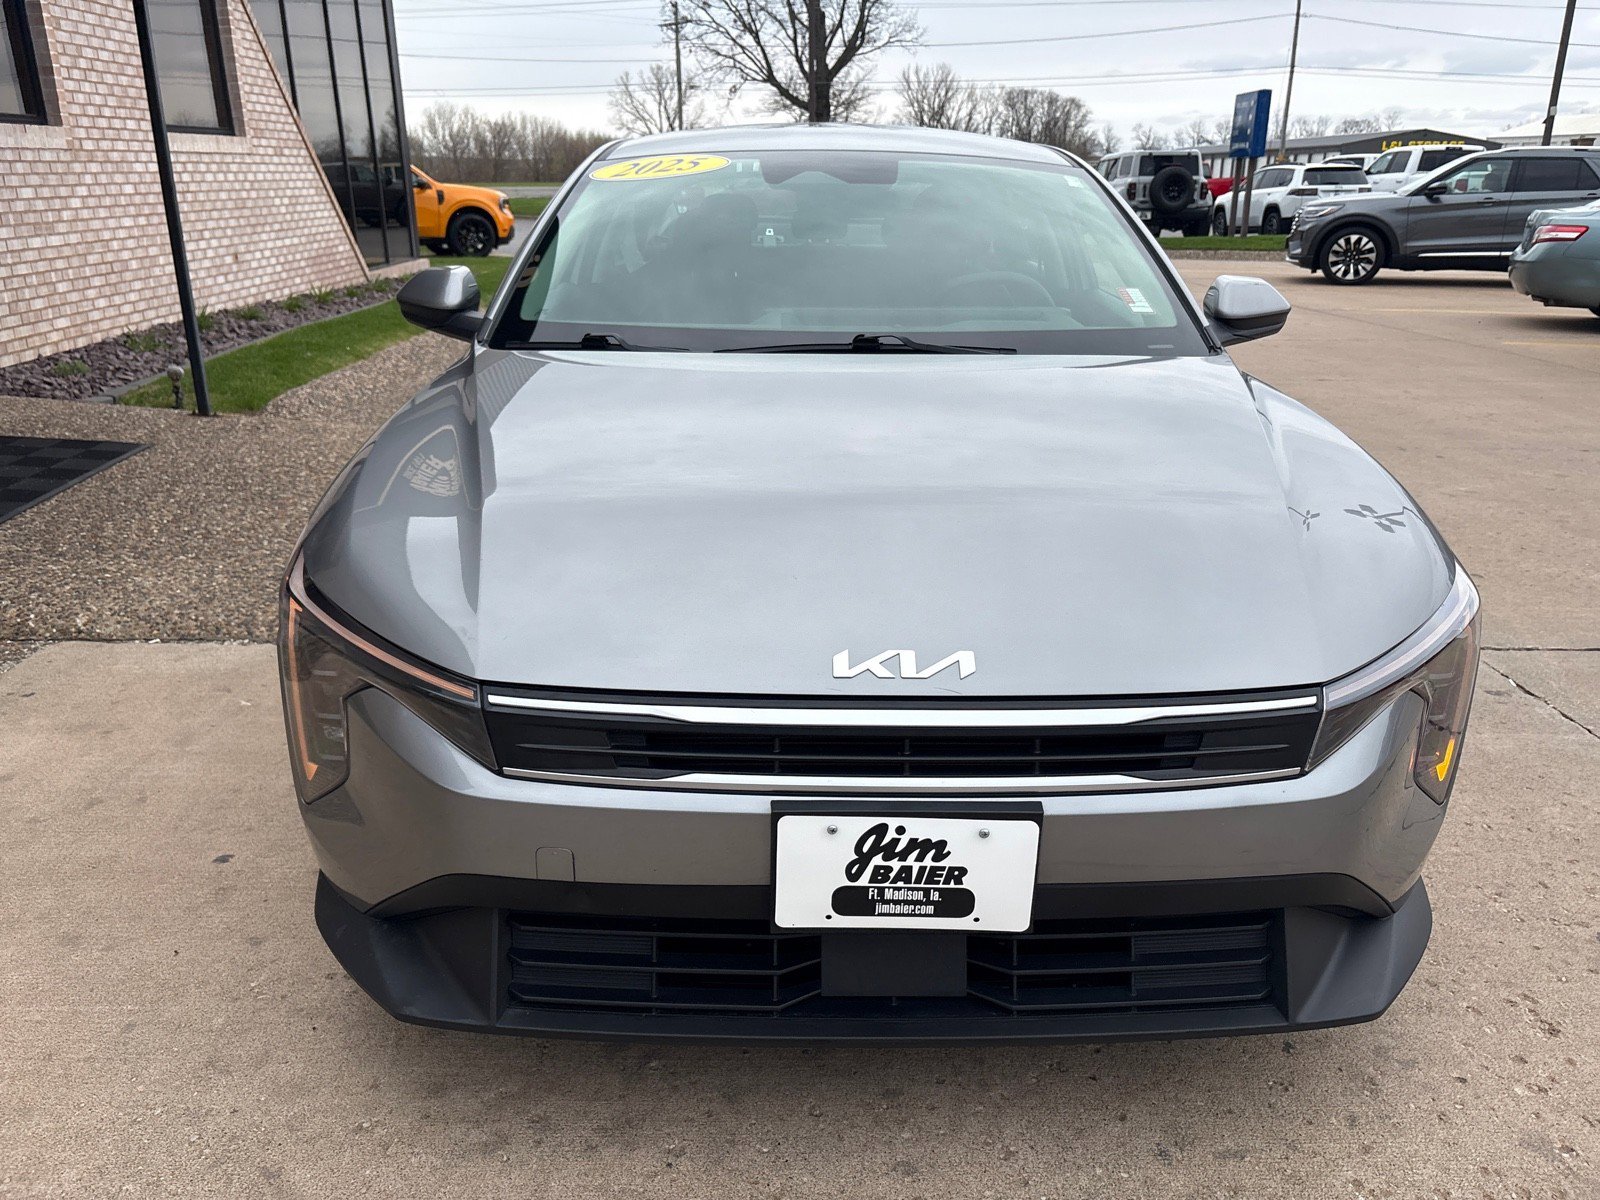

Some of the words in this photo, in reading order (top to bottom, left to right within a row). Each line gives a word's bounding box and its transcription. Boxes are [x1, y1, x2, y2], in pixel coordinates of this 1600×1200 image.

[608, 157, 710, 178] 2025
[845, 822, 951, 883] Jim
[868, 864, 969, 886] BAIER
[868, 887, 881, 900] Ft.
[884, 888, 927, 902] Madison,
[930, 889, 942, 901] Ia.
[875, 902, 935, 915] jimbaier.com
